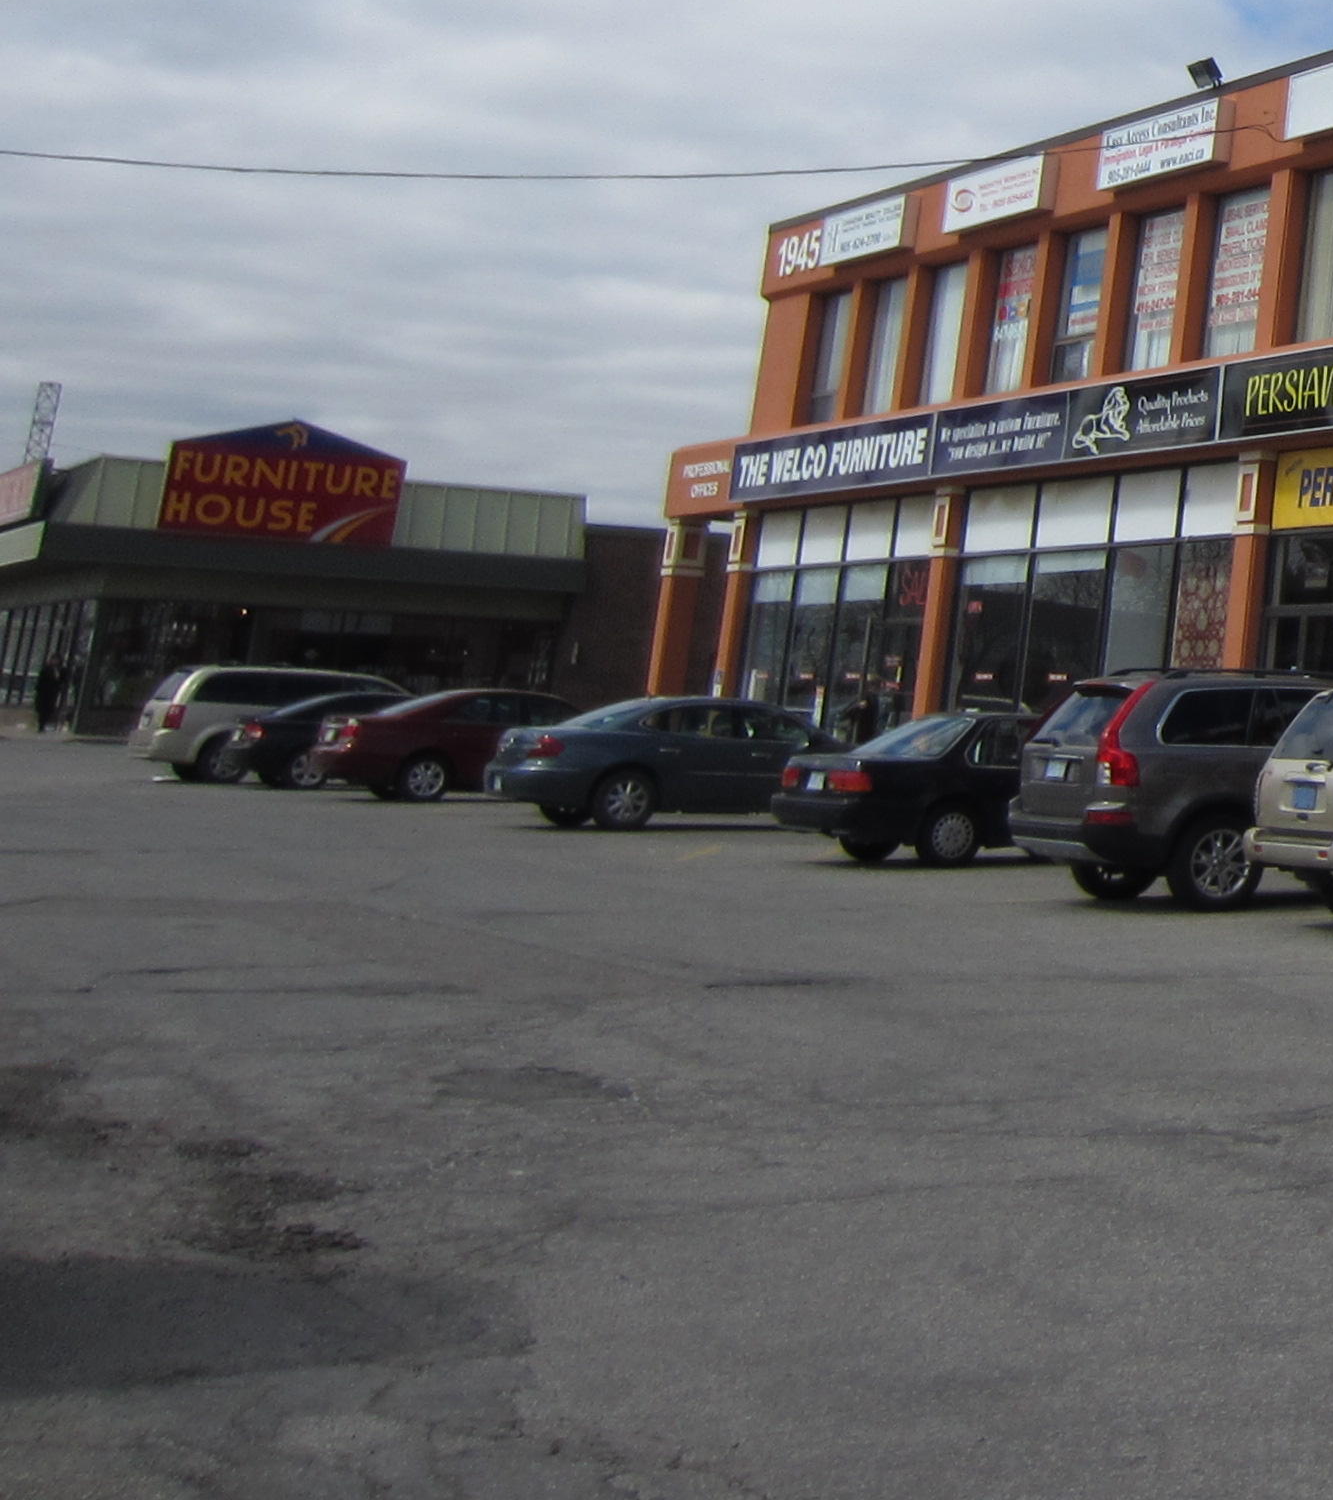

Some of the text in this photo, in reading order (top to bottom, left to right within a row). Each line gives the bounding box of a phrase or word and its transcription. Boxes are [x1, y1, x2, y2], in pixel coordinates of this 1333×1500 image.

[778, 228, 822, 277] 1945
[1136, 412, 1206, 434] Affordable Prices
[1138, 388, 1209, 415] Quality Products
[174, 450, 400, 499] FURNITURE
[738, 428, 928, 488] THE WELCO FURNITURE
[164, 490, 317, 533] HOUSE
